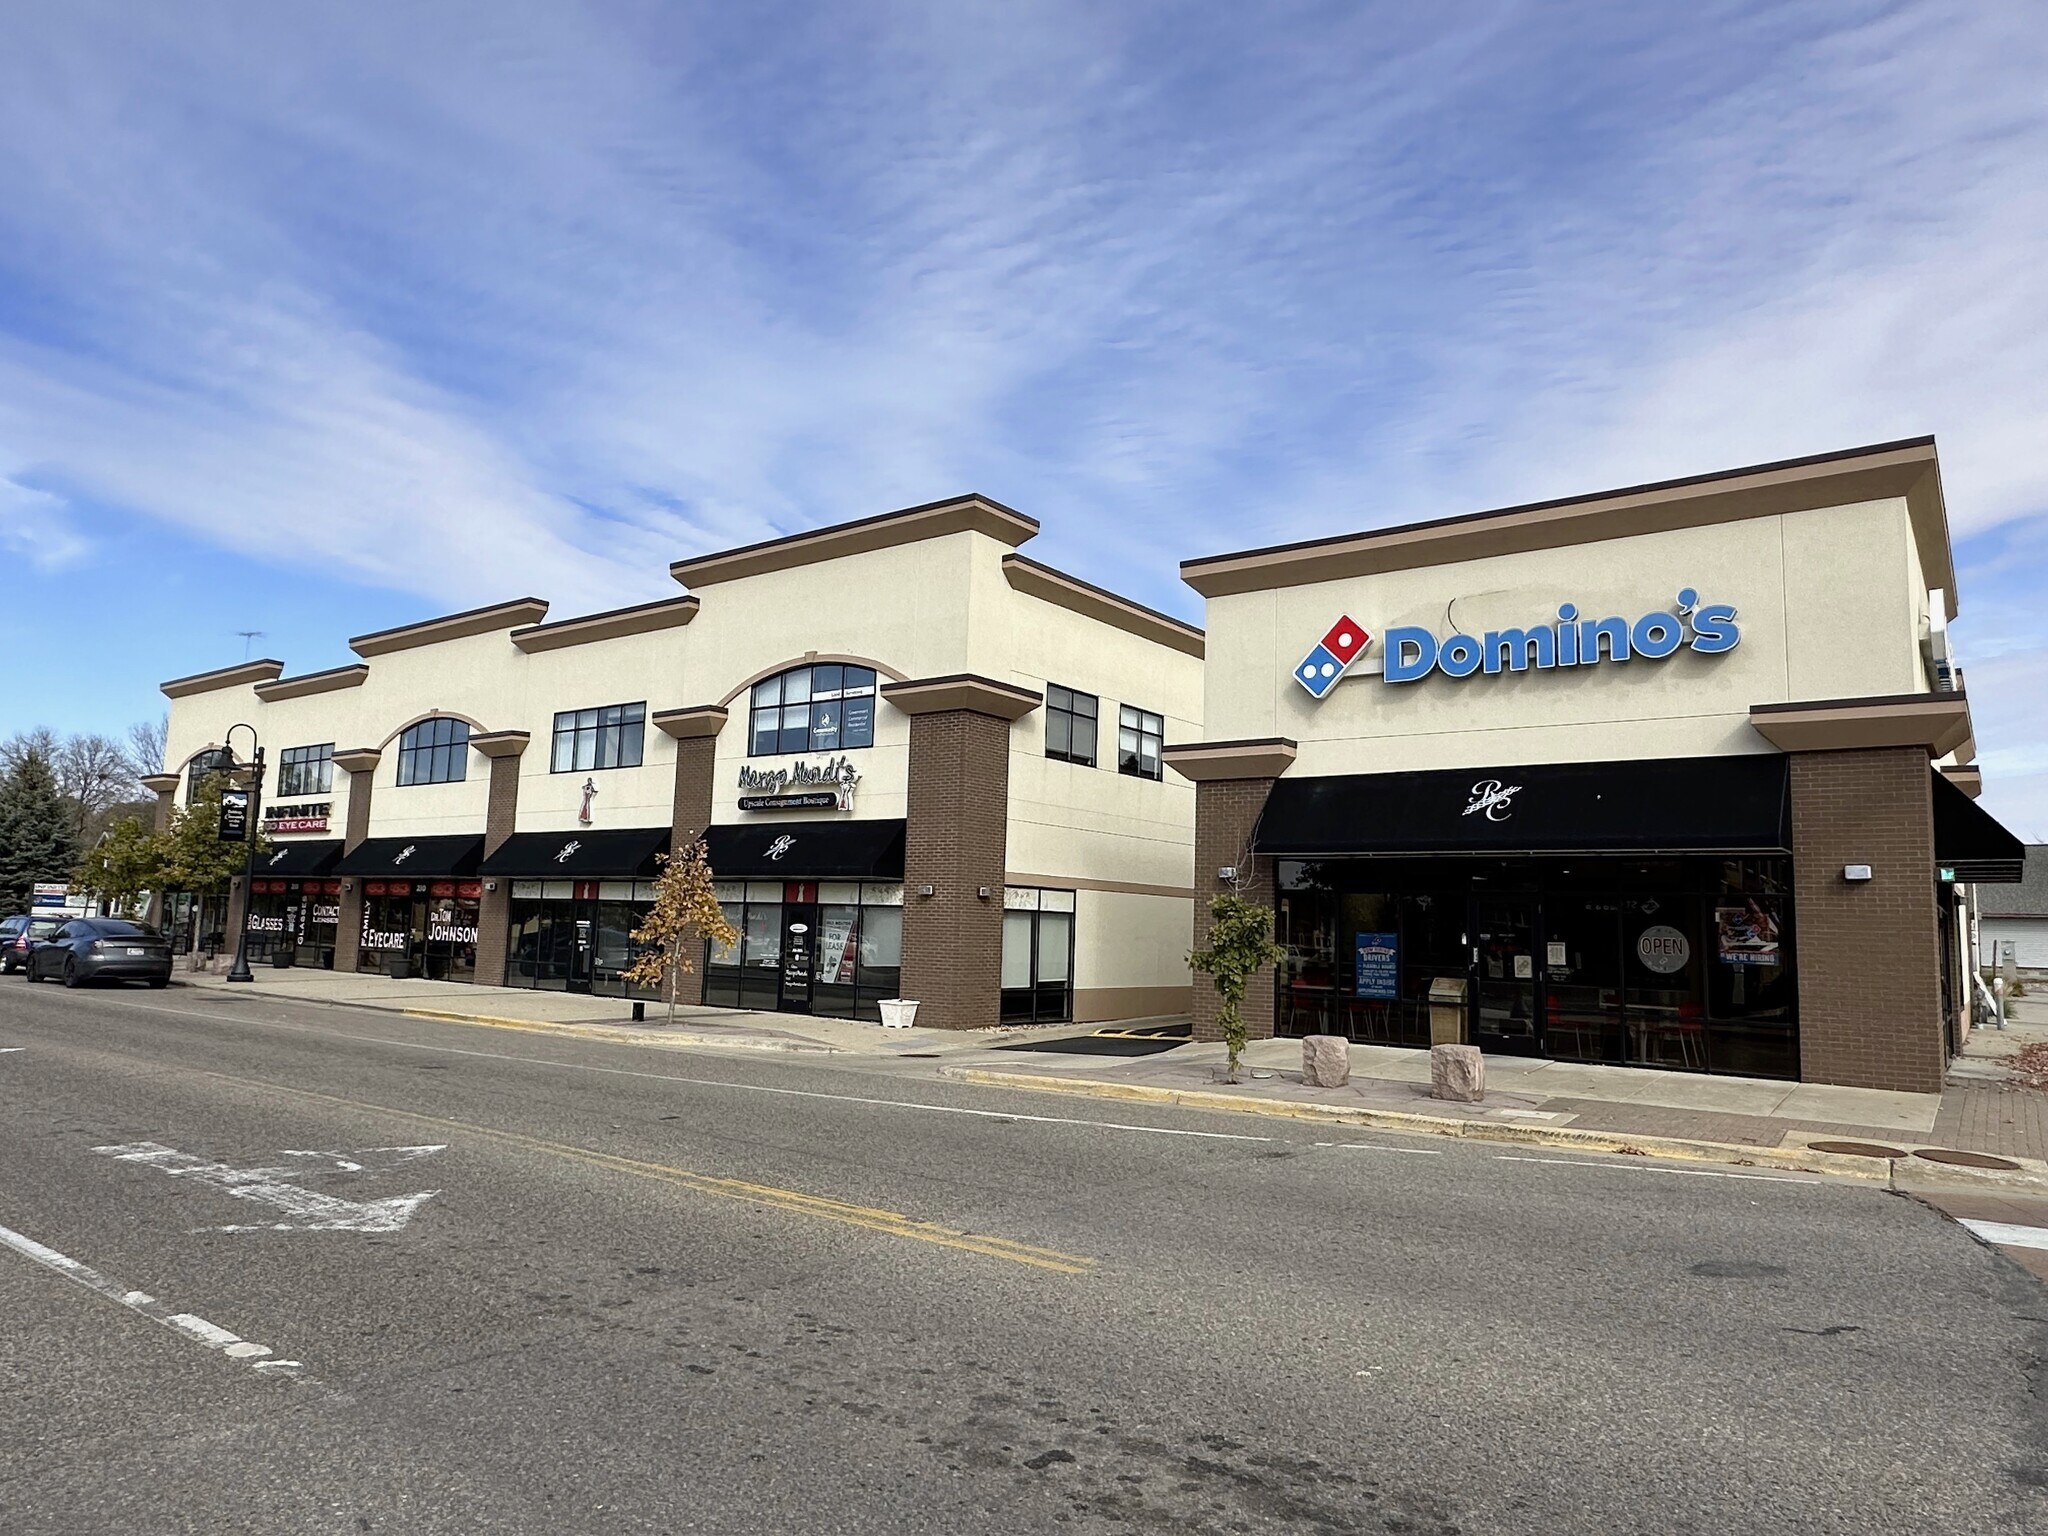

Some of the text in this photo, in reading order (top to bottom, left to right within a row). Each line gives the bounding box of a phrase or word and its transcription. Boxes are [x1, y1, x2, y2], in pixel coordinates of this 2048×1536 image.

[1383, 587, 1741, 684] Domino's
[279, 820, 326, 830] EYE CARE
[252, 914, 283, 931] GLASSES
[360, 900, 371, 947] FAMILY
[368, 929, 405, 949] EYECARE
[428, 923, 479, 943] JOHNSON
[828, 932, 842, 941] FOR
[825, 941, 845, 951] LEASE
[1640, 937, 1683, 955] OPEN
[1363, 954, 1390, 962] DRIVERS
[1726, 953, 1748, 961] WE'RE
[1750, 953, 1775, 962] HIRING
